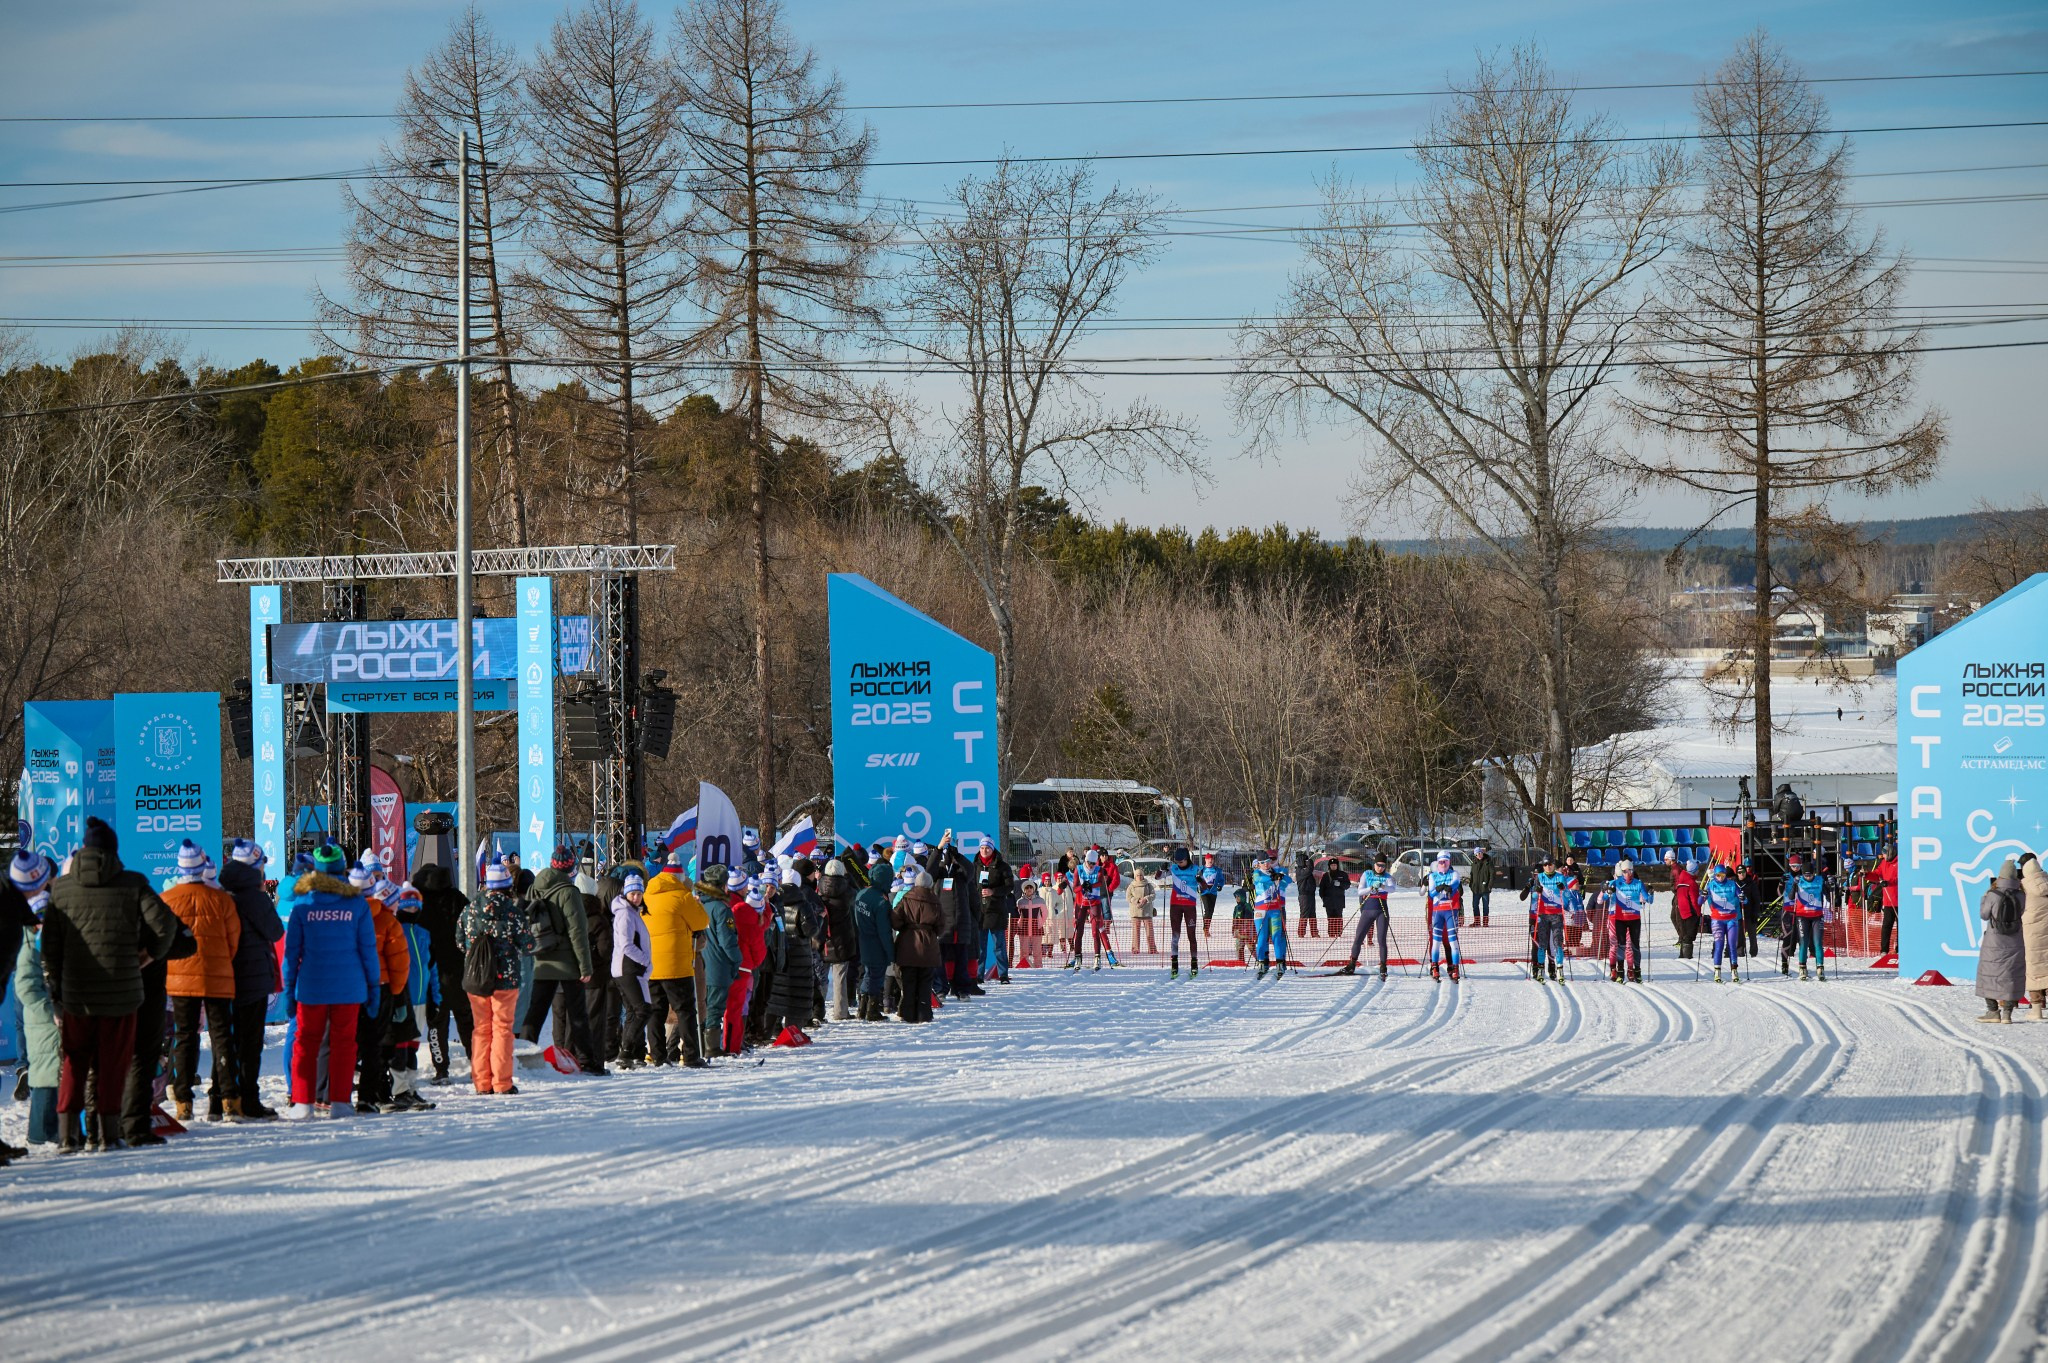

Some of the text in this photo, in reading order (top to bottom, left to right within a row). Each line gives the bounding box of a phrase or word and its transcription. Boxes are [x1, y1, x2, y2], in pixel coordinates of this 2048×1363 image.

[336, 622, 485, 651] ЛЫЖНЯ
[331, 650, 490, 680] РОССИИ
[850, 661, 931, 678] ЛЫЖНЯ
[1962, 663, 2045, 679] ЛЫЖНЯ
[850, 680, 931, 696] РОССИИ
[1962, 683, 2046, 697] РОССИИ
[341, 690, 495, 702] СТАРТУЕТ ВСЯ РОСИЯ
[851, 702, 932, 726] 2025
[1962, 704, 2046, 726] 2025
[30, 749, 59, 758] ЛЫЖНЯ
[30, 760, 59, 768] РОССИИ
[1960, 760, 2047, 770] АСТРАМЕД-МС
[31, 771, 60, 783] 2025
[135, 784, 201, 797] ЛЫЖНЯ
[135, 799, 201, 811] РОССИИ
[1910, 685, 1943, 921] СТАРТ
[136, 815, 202, 832] 2025
[1181, 880, 1187, 893] 6
[1548, 890, 1554, 902] 3
[307, 910, 353, 921] RUSSIA
[430, 1028, 444, 1064] adidas
